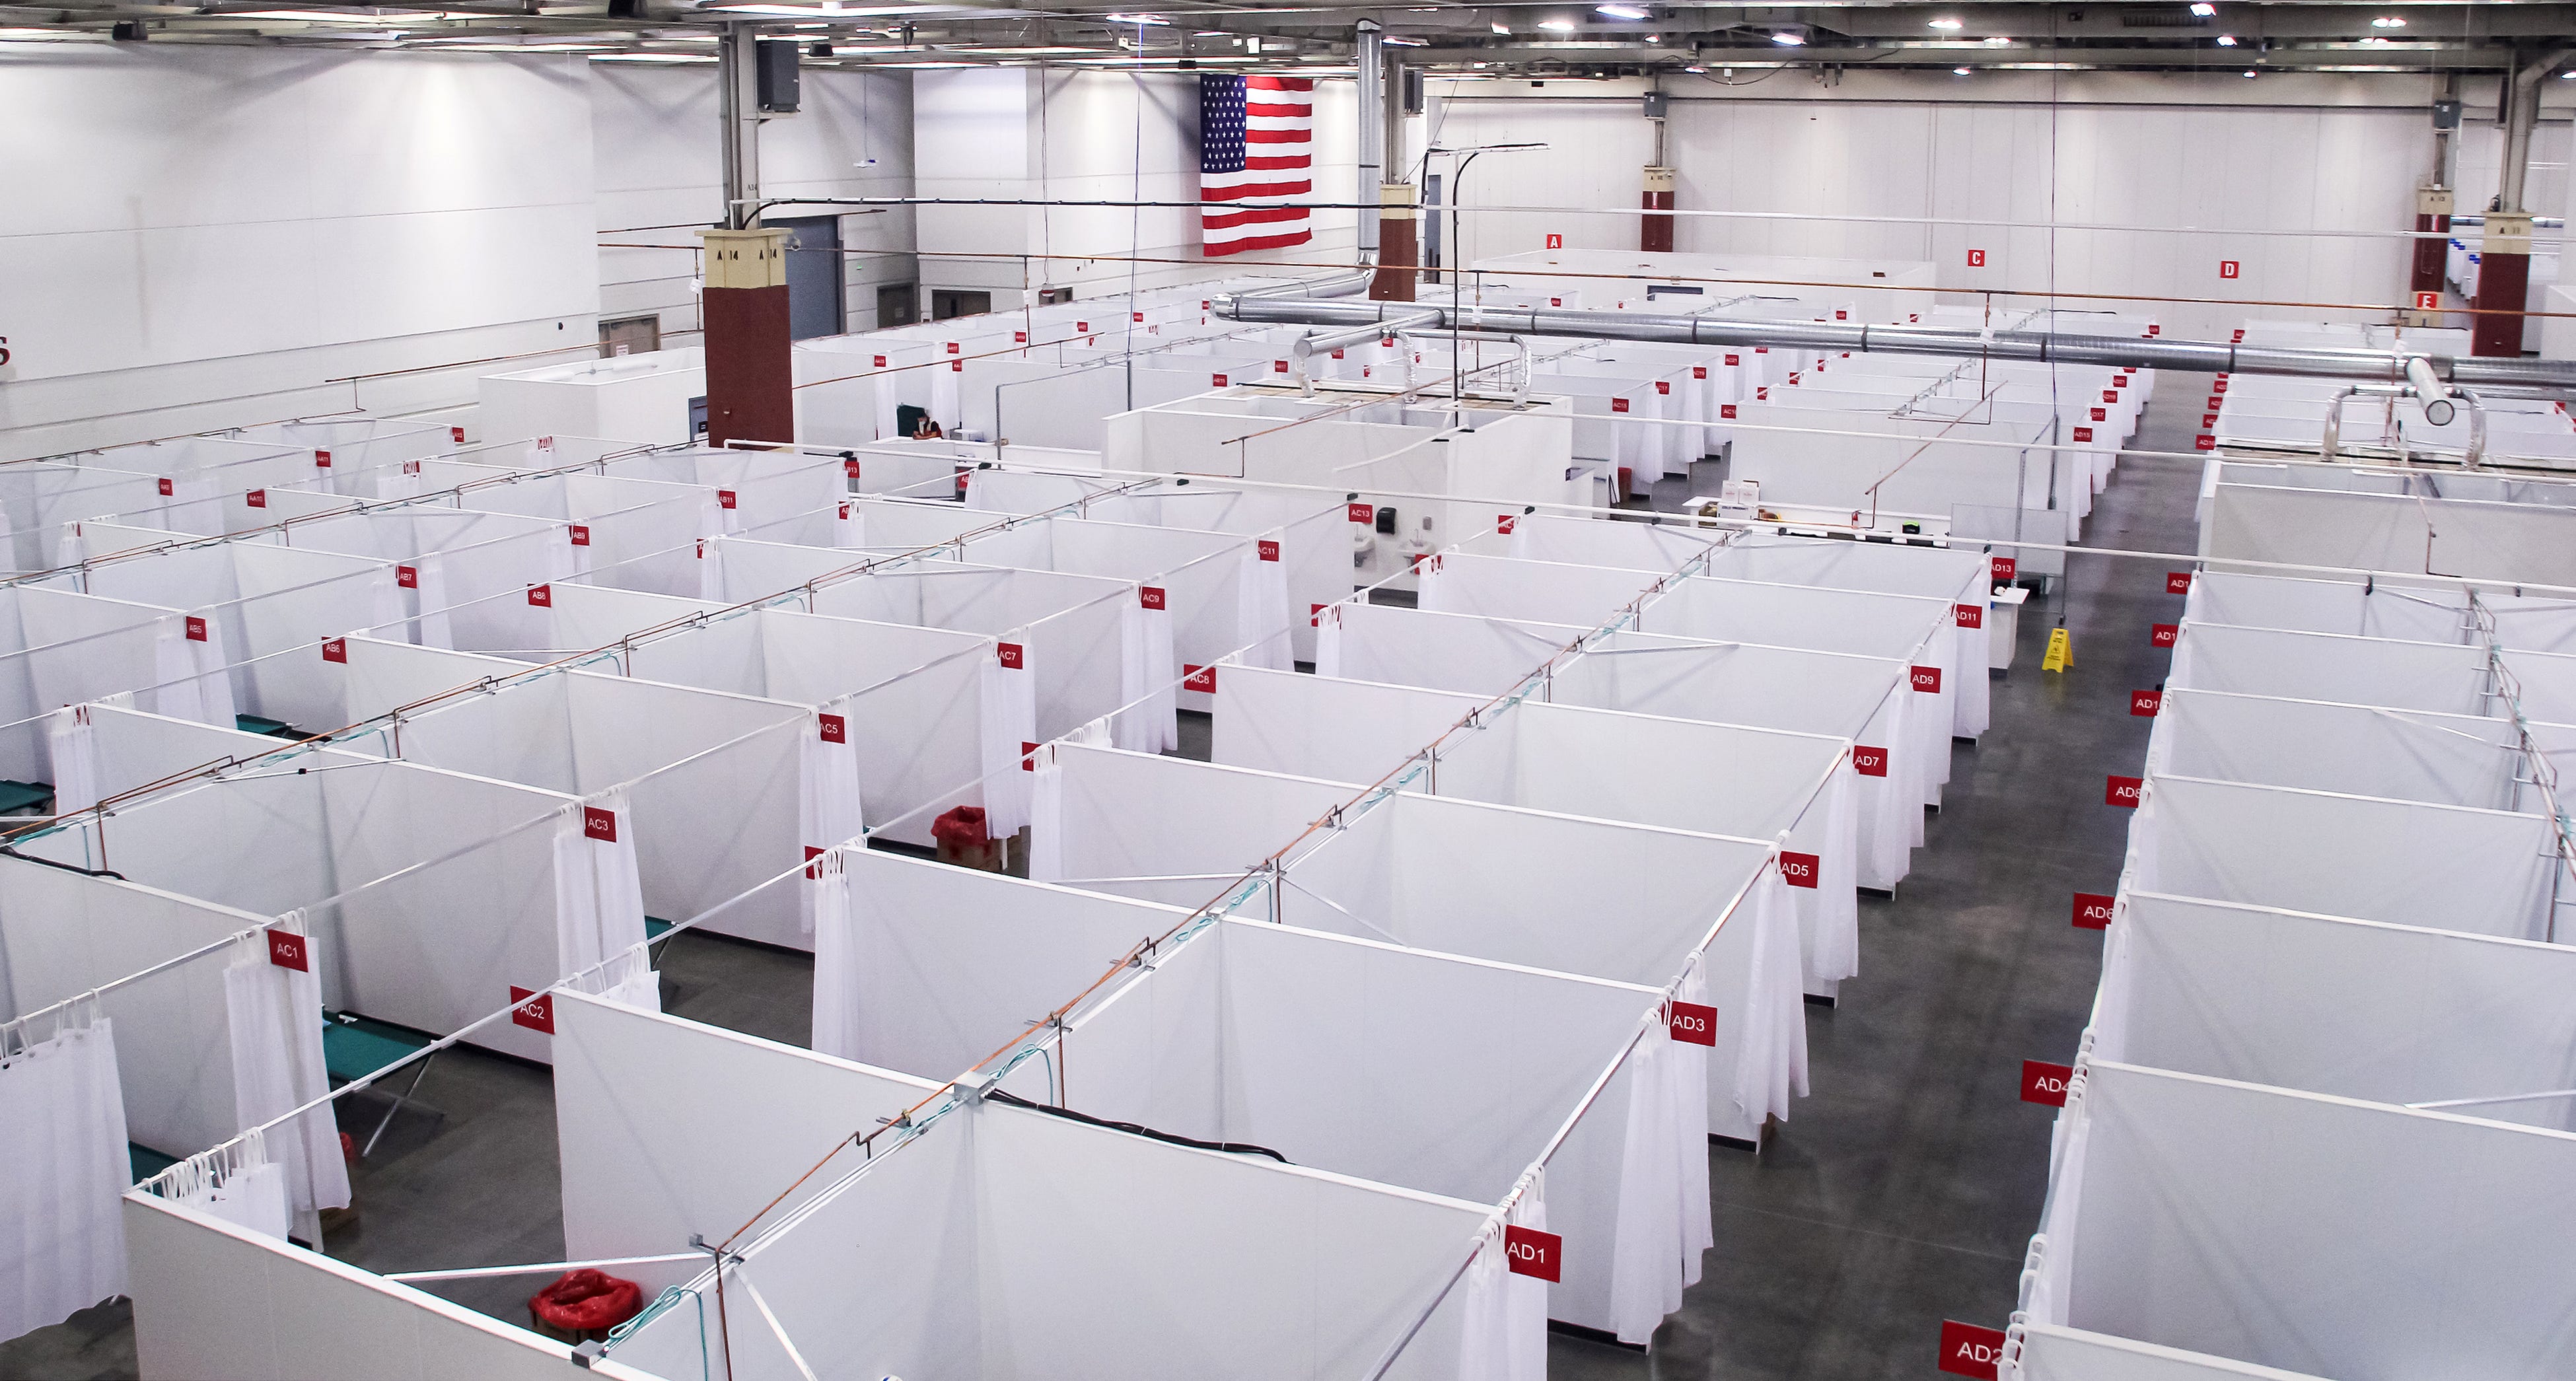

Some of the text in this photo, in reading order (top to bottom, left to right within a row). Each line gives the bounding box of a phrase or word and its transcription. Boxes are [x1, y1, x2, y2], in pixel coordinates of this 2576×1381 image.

[1550, 236, 1558, 248] A
[717, 250, 739, 261] A 14
[759, 248, 777, 261] A 14
[1972, 252, 1981, 264] C
[2225, 264, 2235, 276] D
[2423, 296, 2431, 308] E
[1991, 564, 2011, 573] AD13
[532, 591, 546, 600] AB8
[1143, 594, 1159, 603] AC9
[1956, 612, 1976, 621] AD11
[2156, 631, 2176, 640] AD1
[326, 643, 340, 653] AB6
[999, 651, 1017, 660] AC7
[1190, 673, 1209, 684] AC8
[1912, 674, 1934, 685] AD9
[2136, 699, 2159, 709] AD1
[819, 723, 838, 734] AC5
[1855, 755, 1880, 767] AD7
[588, 818, 608, 832] AC3
[1781, 862, 1809, 876] AD5
[2084, 905, 2113, 920] AD6
[277, 942, 298, 959] AC1
[520, 1003, 545, 1020] AC2
[1672, 1014, 1705, 1032] AD3
[1507, 1241, 1545, 1264] AD1
[1956, 1341, 2003, 1366] AD2
